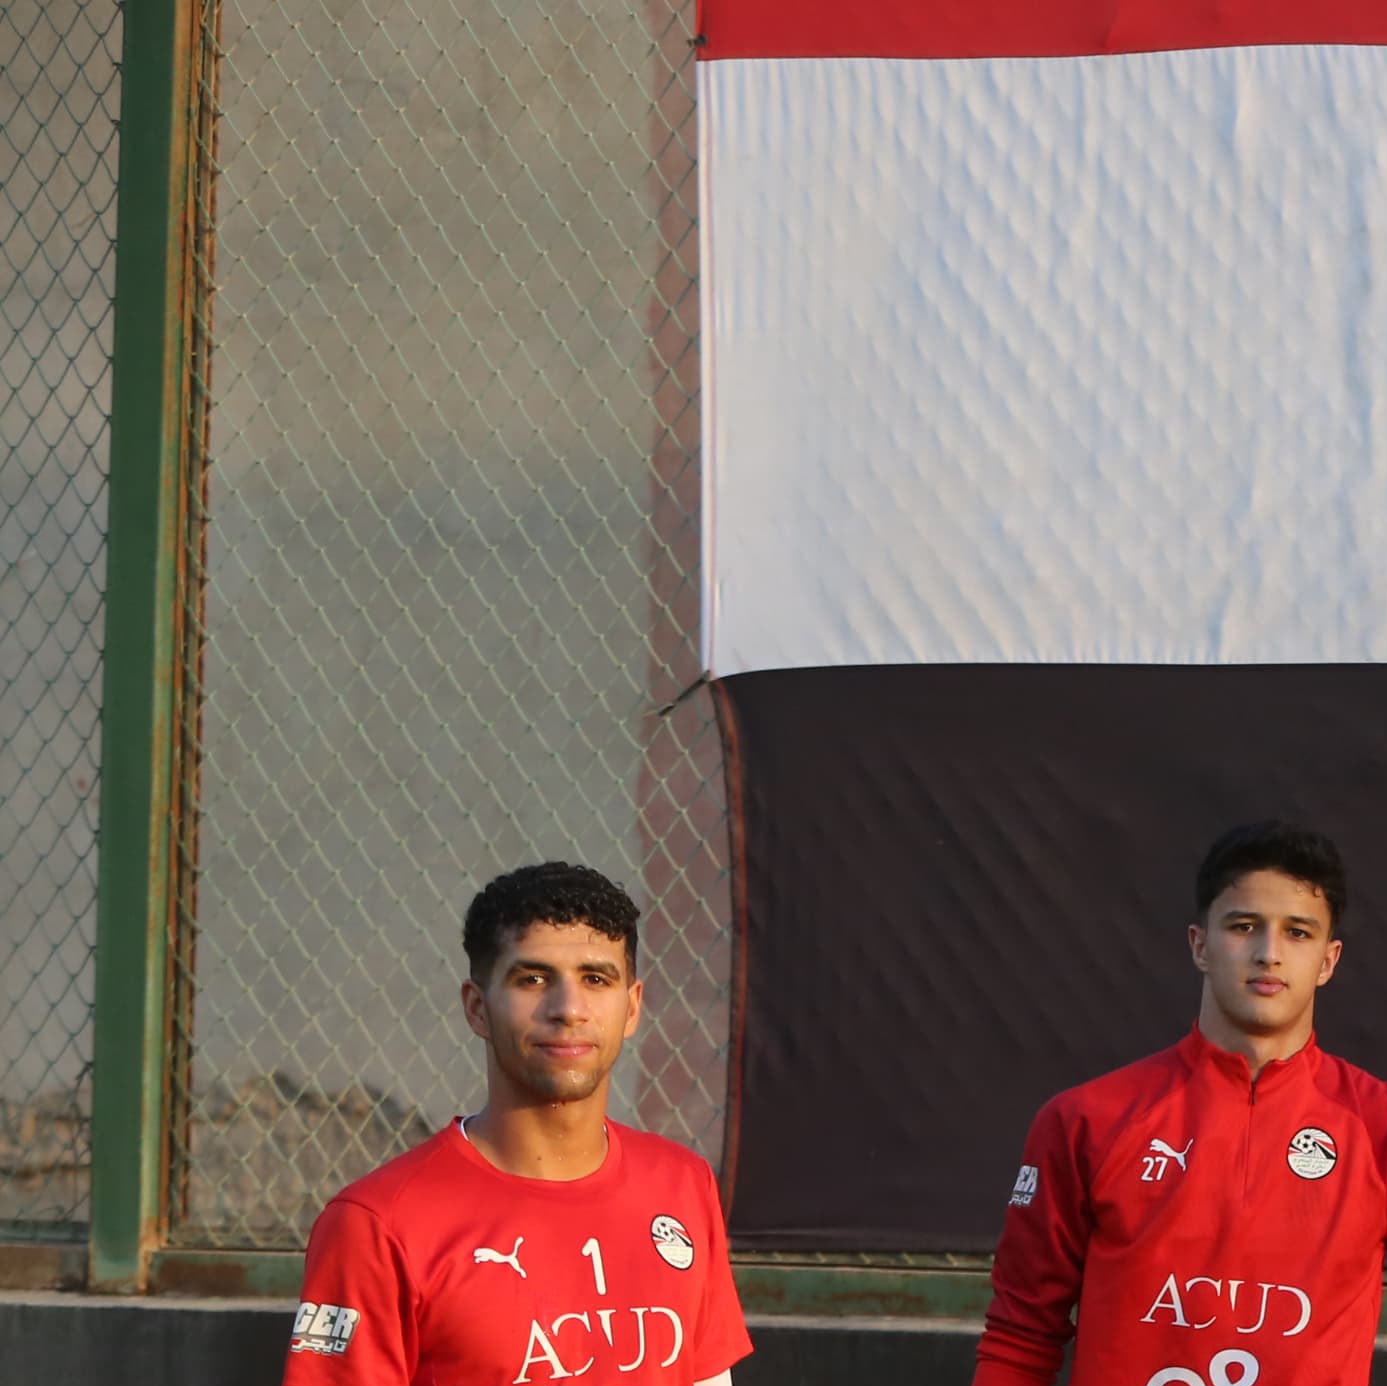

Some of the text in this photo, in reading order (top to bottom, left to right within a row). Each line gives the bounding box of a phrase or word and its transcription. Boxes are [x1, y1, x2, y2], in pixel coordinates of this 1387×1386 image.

[1141, 1156, 1168, 1182] 27
[582, 1238, 606, 1295] 1
[292, 1302, 360, 1340] GER
[1141, 1274, 1311, 1336] ACUD
[513, 1307, 684, 1385] ACUD
